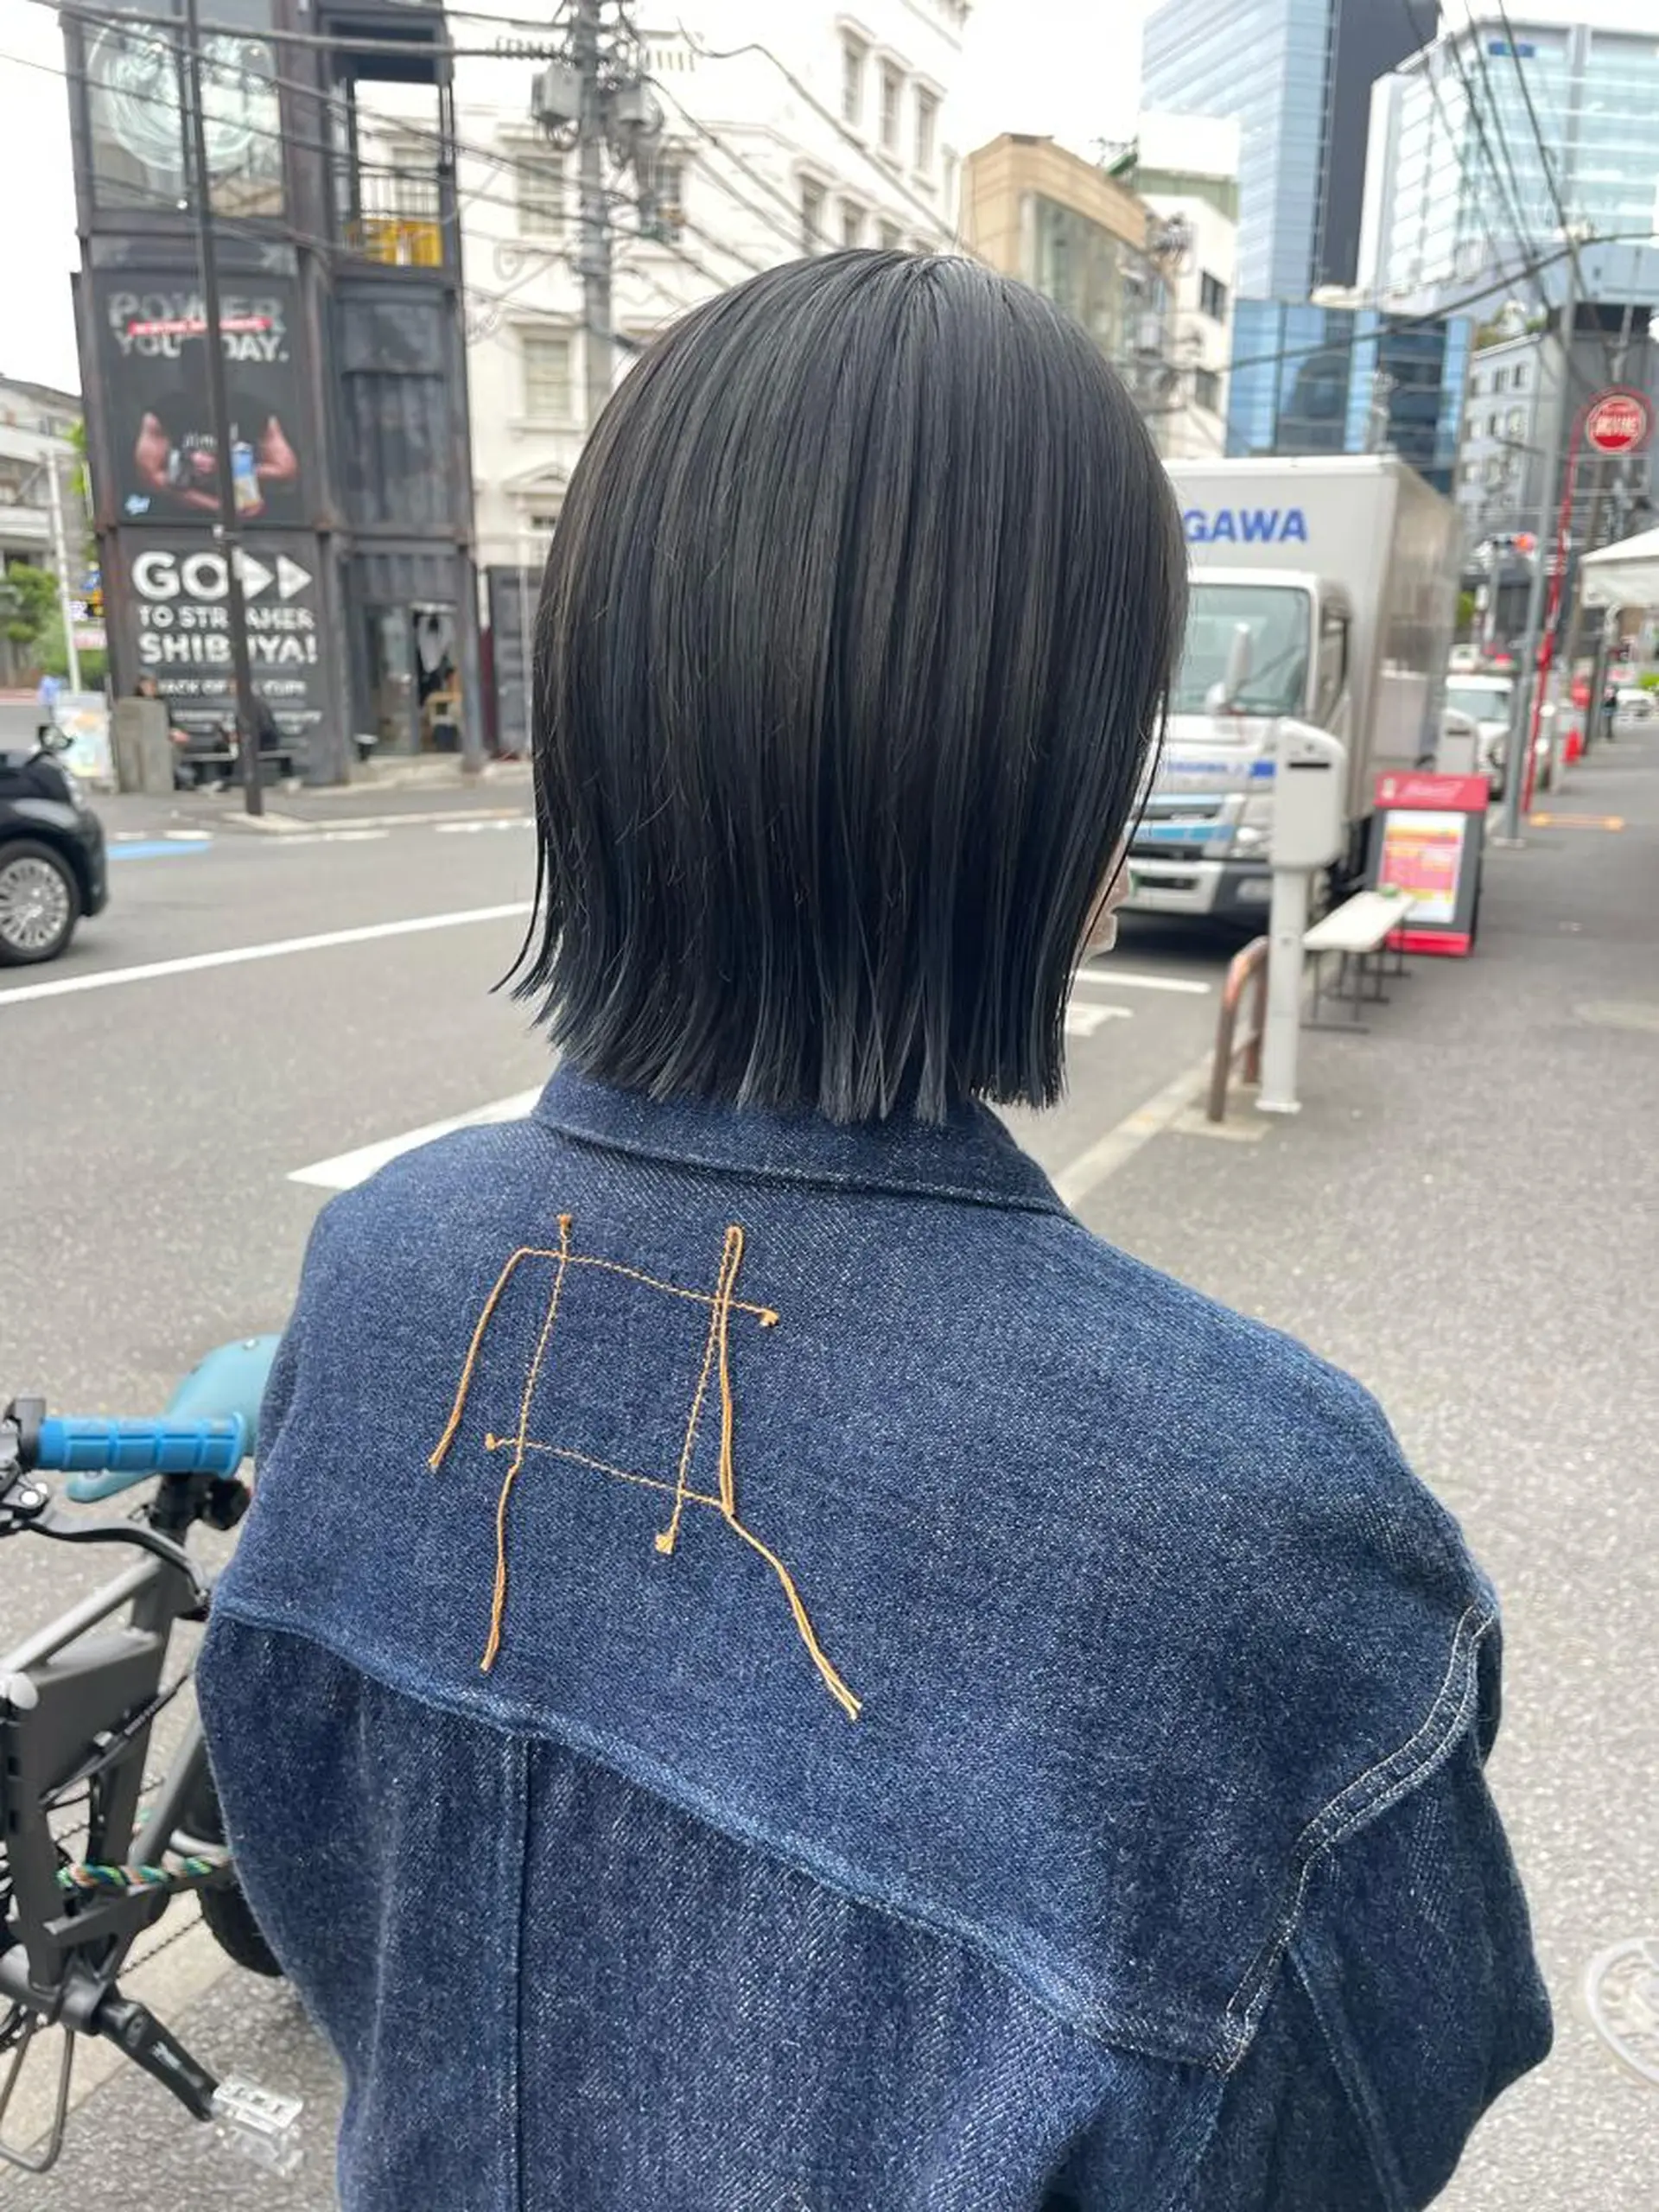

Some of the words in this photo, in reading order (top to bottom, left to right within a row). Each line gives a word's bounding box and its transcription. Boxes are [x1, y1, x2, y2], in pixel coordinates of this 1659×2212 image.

[108, 292, 287, 332] POWER
[113, 329, 188, 358] YOU
[131, 550, 229, 601] GO
[138, 605, 174, 627] TO
[178, 605, 315, 630] STRAMER
